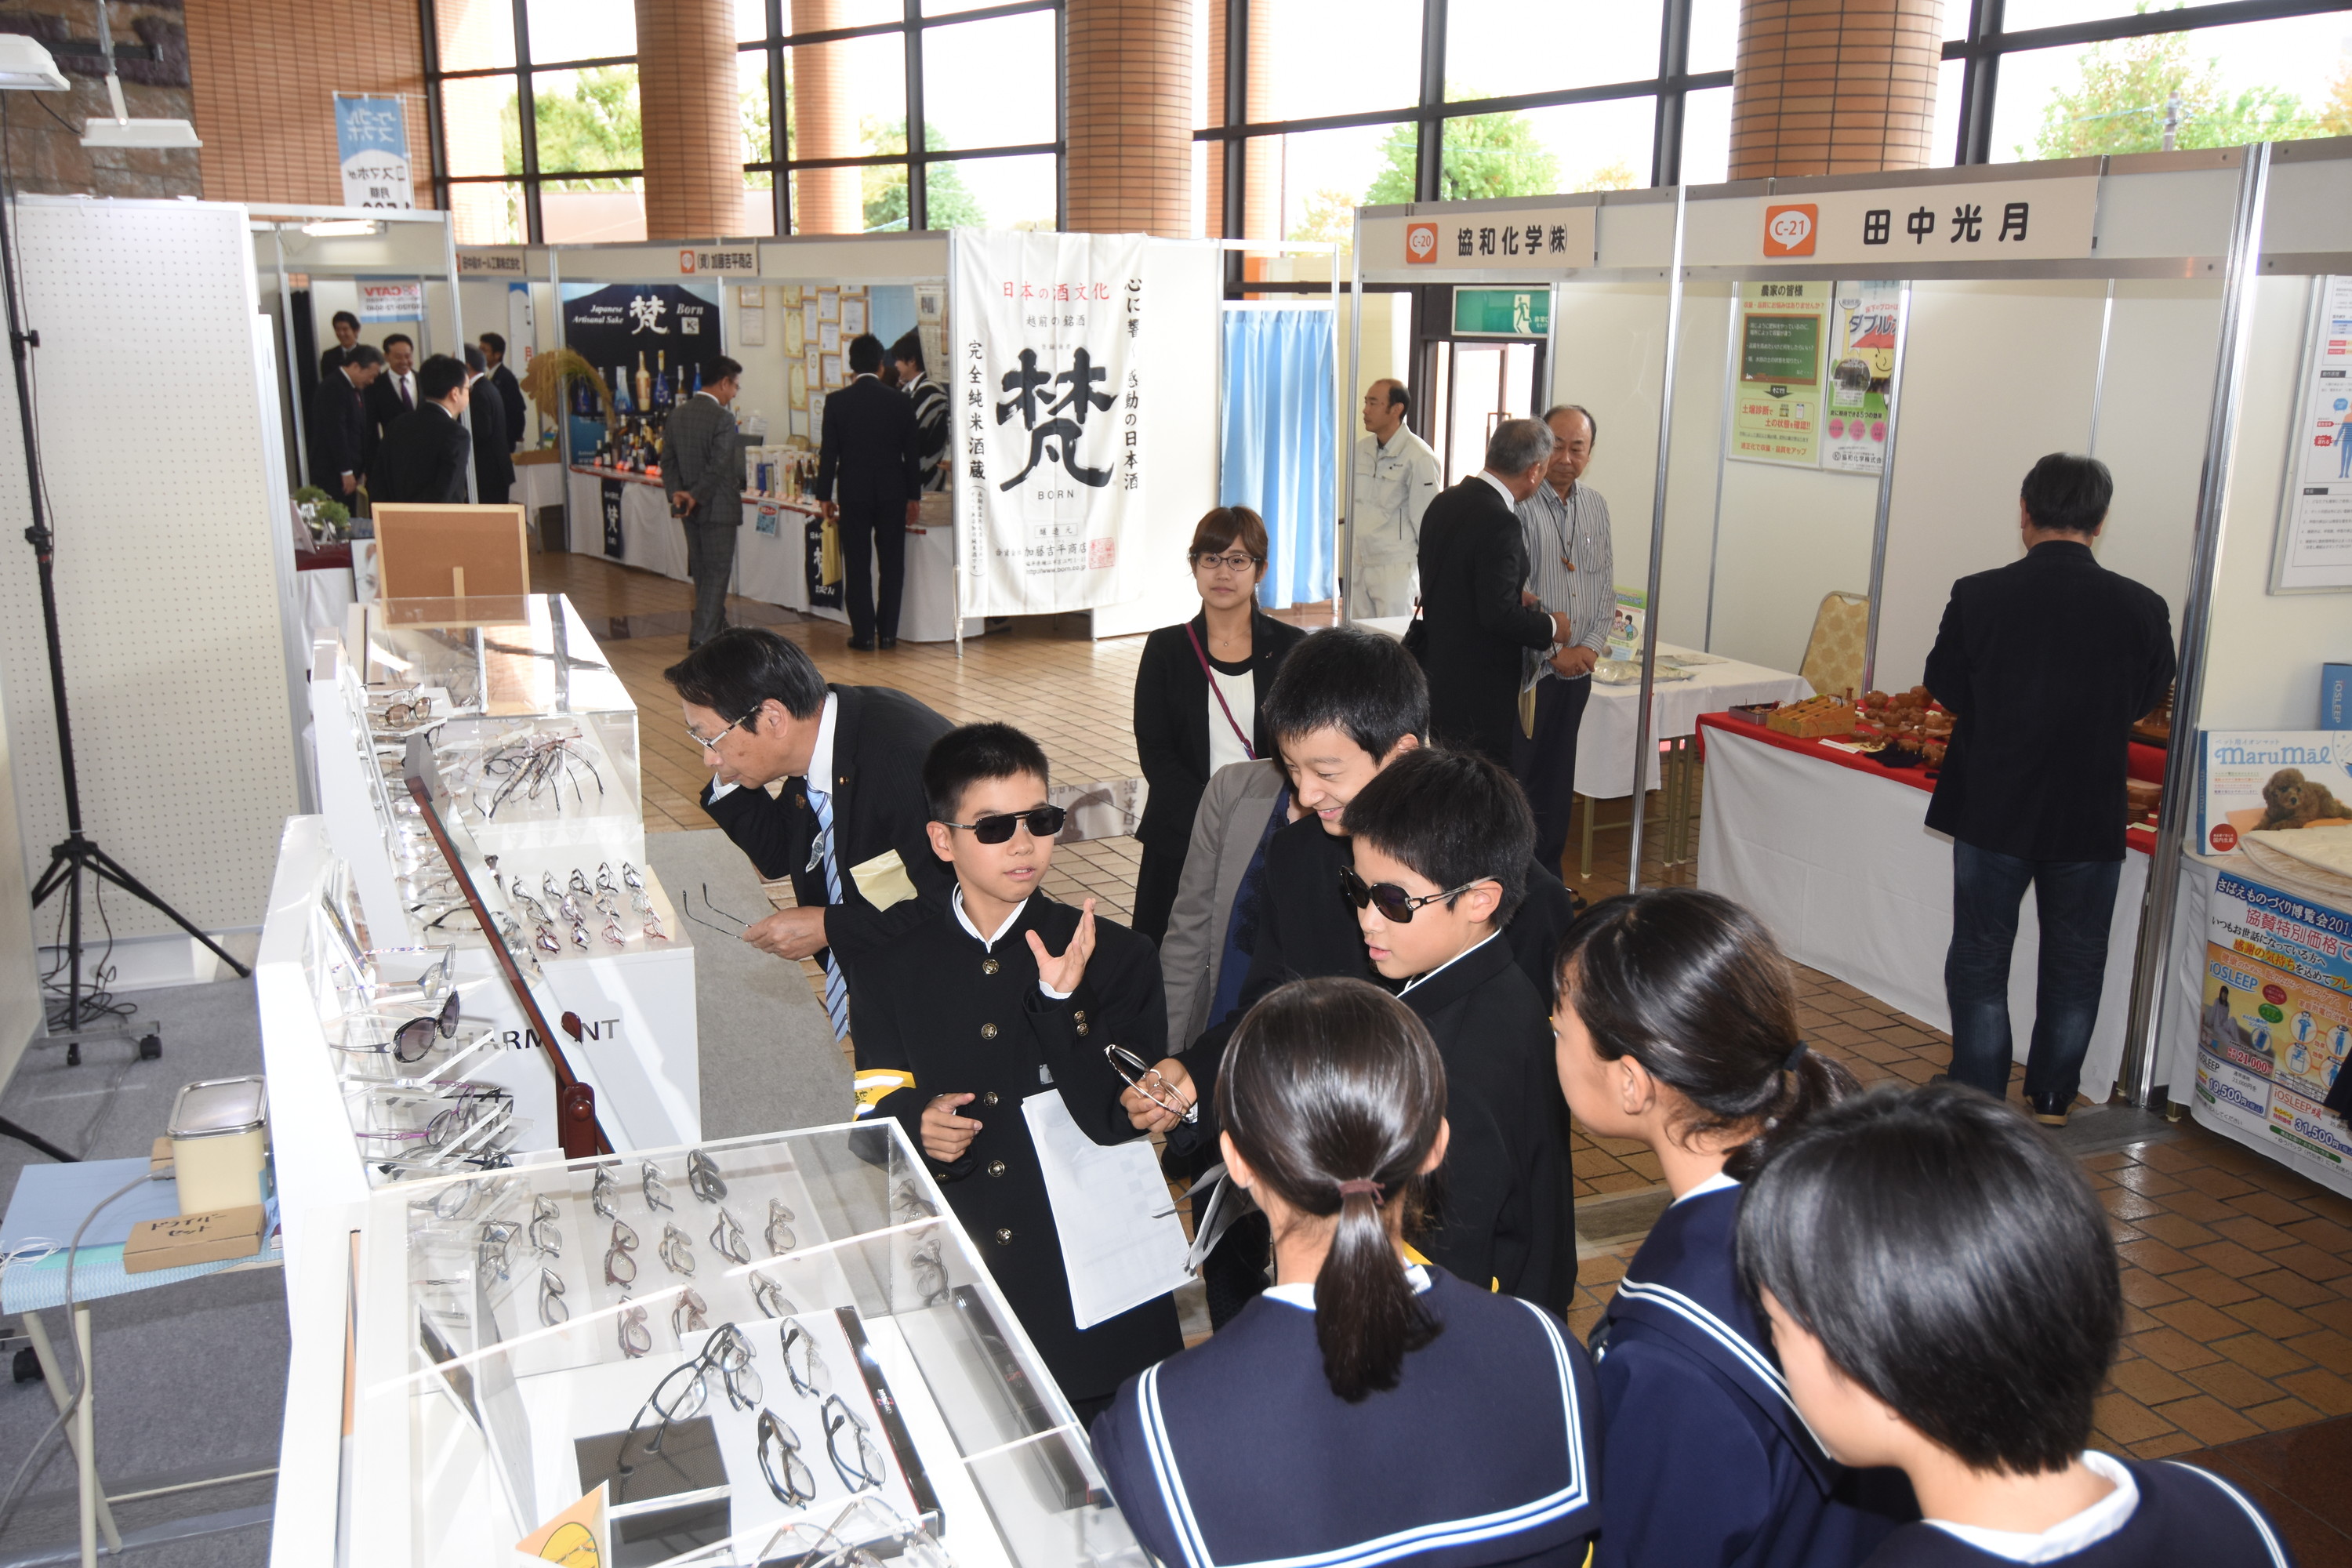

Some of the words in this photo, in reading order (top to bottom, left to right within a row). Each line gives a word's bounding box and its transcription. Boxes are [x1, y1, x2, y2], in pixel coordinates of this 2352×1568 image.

[1774, 220, 1806, 237] C-21
[1863, 202, 2029, 245] 田中光月
[1412, 234, 1432, 248] C-20
[1003, 281, 1110, 301] 日本の酒文化
[1761, 285, 1803, 296] 農家の皆様
[590, 304, 623, 313] Japanese
[630, 295, 667, 335] 梵
[677, 303, 704, 315] Born
[573, 315, 604, 324] Artisanal
[606, 315, 624, 324] Sake
[1026, 314, 1086, 328] 越前の銘酒
[968, 339, 985, 480] 完全純米酒蔵
[996, 347, 1119, 492] 梵
[1037, 489, 1074, 500] BORN
[1025, 543, 1087, 557] 加藤吉平商店
[2217, 878, 2352, 938] さばえものづくり博覧会201
[2212, 916, 2327, 967] いつもお世話になっている方へ
[2209, 960, 2259, 990] iOSLEEP
[150, 1212, 227, 1231] ドライバー
[168, 1225, 212, 1237] セット
